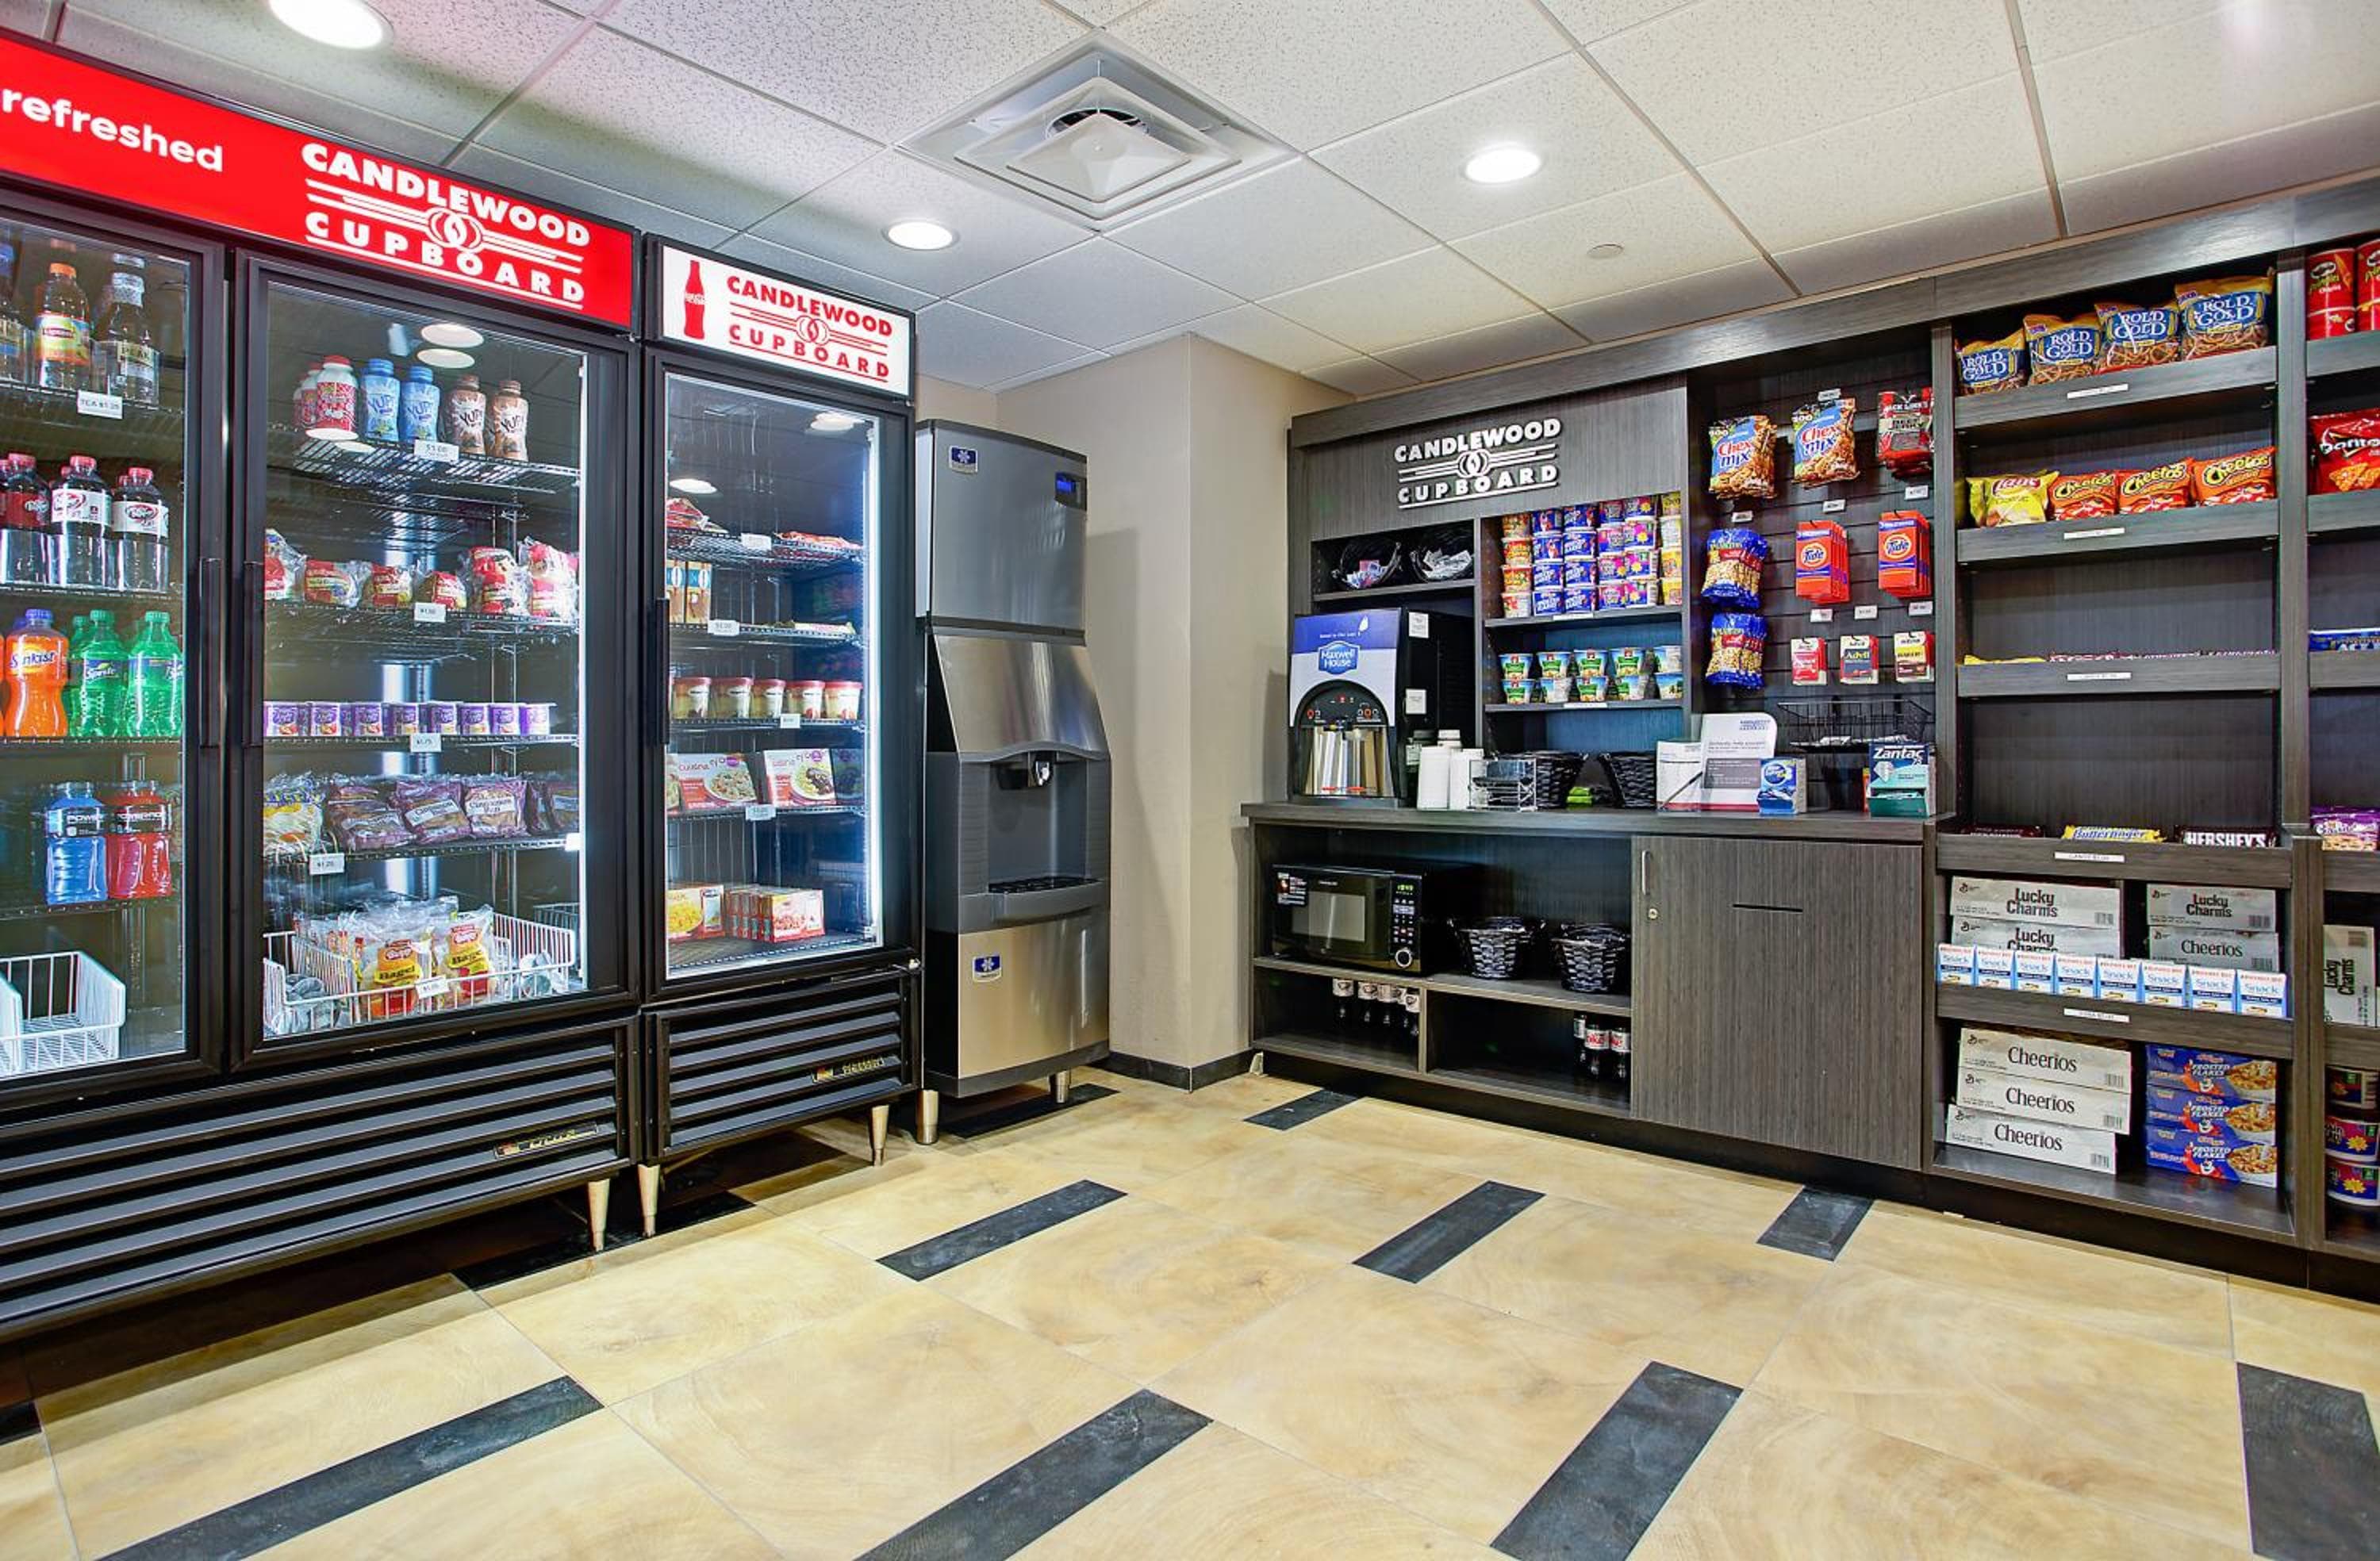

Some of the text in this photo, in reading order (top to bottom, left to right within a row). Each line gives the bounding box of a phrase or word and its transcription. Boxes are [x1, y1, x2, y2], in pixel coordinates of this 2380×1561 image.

[2, 86, 224, 173] refreshed
[301, 144, 590, 247] CANDLEWOOD
[305, 212, 585, 304] CUPBOARD
[727, 276, 892, 336] CANDLEWOOD
[2195, 306, 2254, 326] GOLD
[2114, 321, 2165, 339] GOLD
[729, 324, 889, 377] CUPBOARD
[2046, 342, 2093, 359] GOLD
[1963, 362, 2007, 381] GOLD
[1394, 418, 1561, 462] CANDLEWOOD
[1802, 426, 1840, 443] Chex
[1718, 441, 1753, 456] Chex
[1805, 436, 1837, 456] mix
[2320, 438, 2380, 455] Dorito
[1721, 451, 1750, 468] mix
[2123, 464, 2186, 493] Cheetos
[2205, 455, 2270, 485] Cheetos
[1398, 465, 1558, 503] CUPBOARD
[1804, 549, 1824, 563] Tide
[1887, 540, 1910, 554] Tide
[1321, 649, 1356, 659] Maxwell
[1846, 650, 1870, 659] Advil
[1324, 658, 1353, 669] House
[1873, 748, 1925, 761] Zantac
[2184, 832, 2267, 846] HERSHEY'S
[2015, 888, 2055, 910] Lucky
[2192, 893, 2228, 910] Lucky
[2006, 899, 2059, 918] Charms
[2186, 903, 2232, 918] Charms
[2015, 927, 2055, 945] Lucky
[2181, 939, 2244, 958] Cheerios
[379, 965, 415, 980] Bagel
[2148, 974, 2179, 984] Snack
[2324, 959, 2341, 988] Lucky
[2337, 959, 2355, 995] Charms
[2196, 978, 2228, 988] Snack
[2245, 984, 2278, 994] Snack
[2007, 1045, 2078, 1073] Cheerios
[2006, 1087, 2075, 1114] Cheerios
[1994, 1123, 2063, 1152] Cheerios
